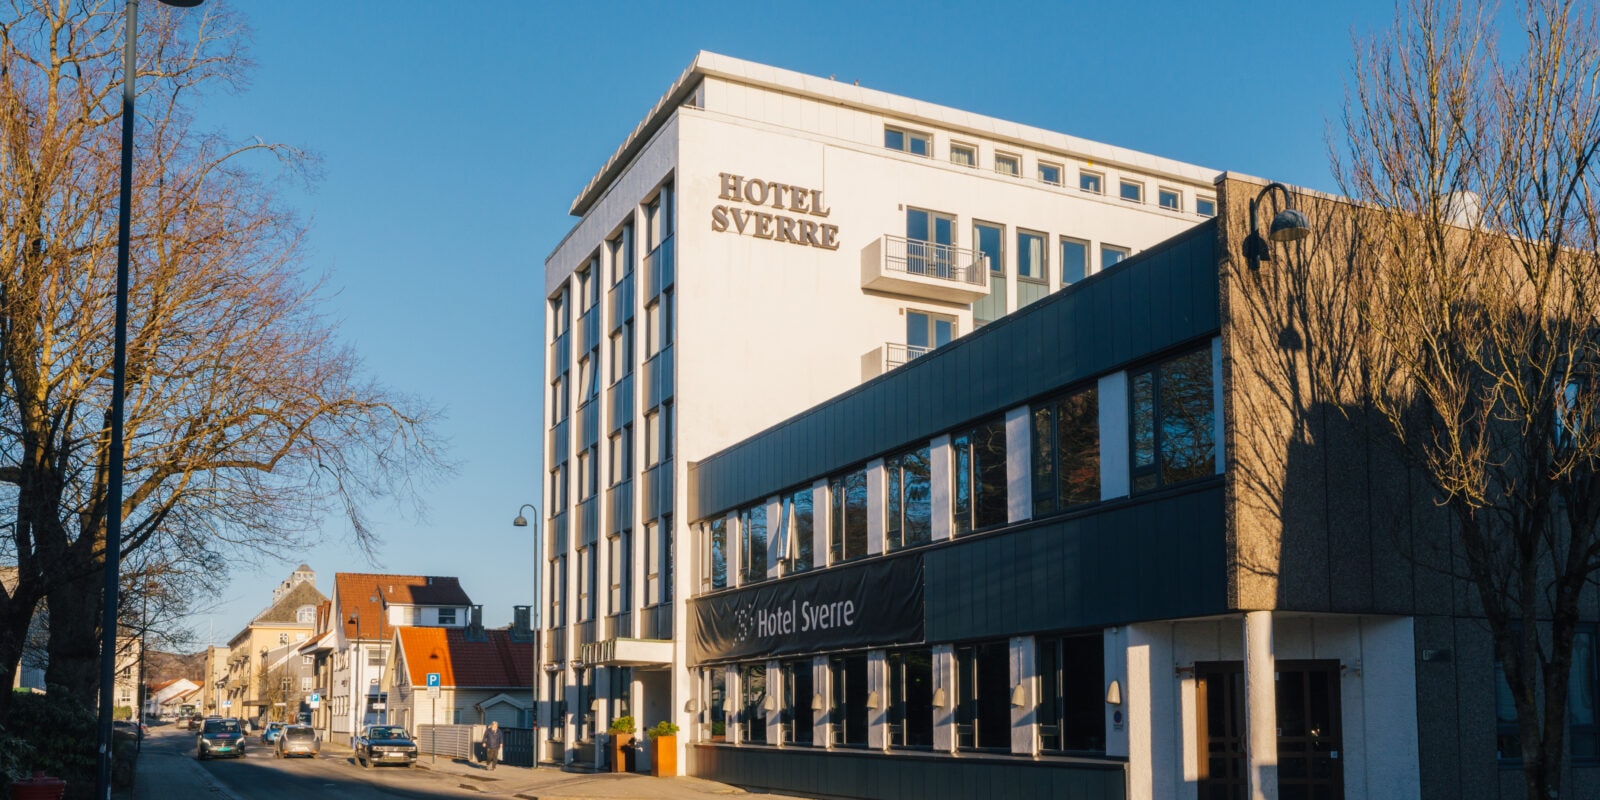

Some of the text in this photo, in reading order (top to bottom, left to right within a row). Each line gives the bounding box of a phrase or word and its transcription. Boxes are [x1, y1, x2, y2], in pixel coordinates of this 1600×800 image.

[718, 172, 831, 218] HOTEL
[711, 204, 841, 251] SVERRE
[758, 599, 855, 638] Hotel Sverre
[430, 674, 438, 686] P
